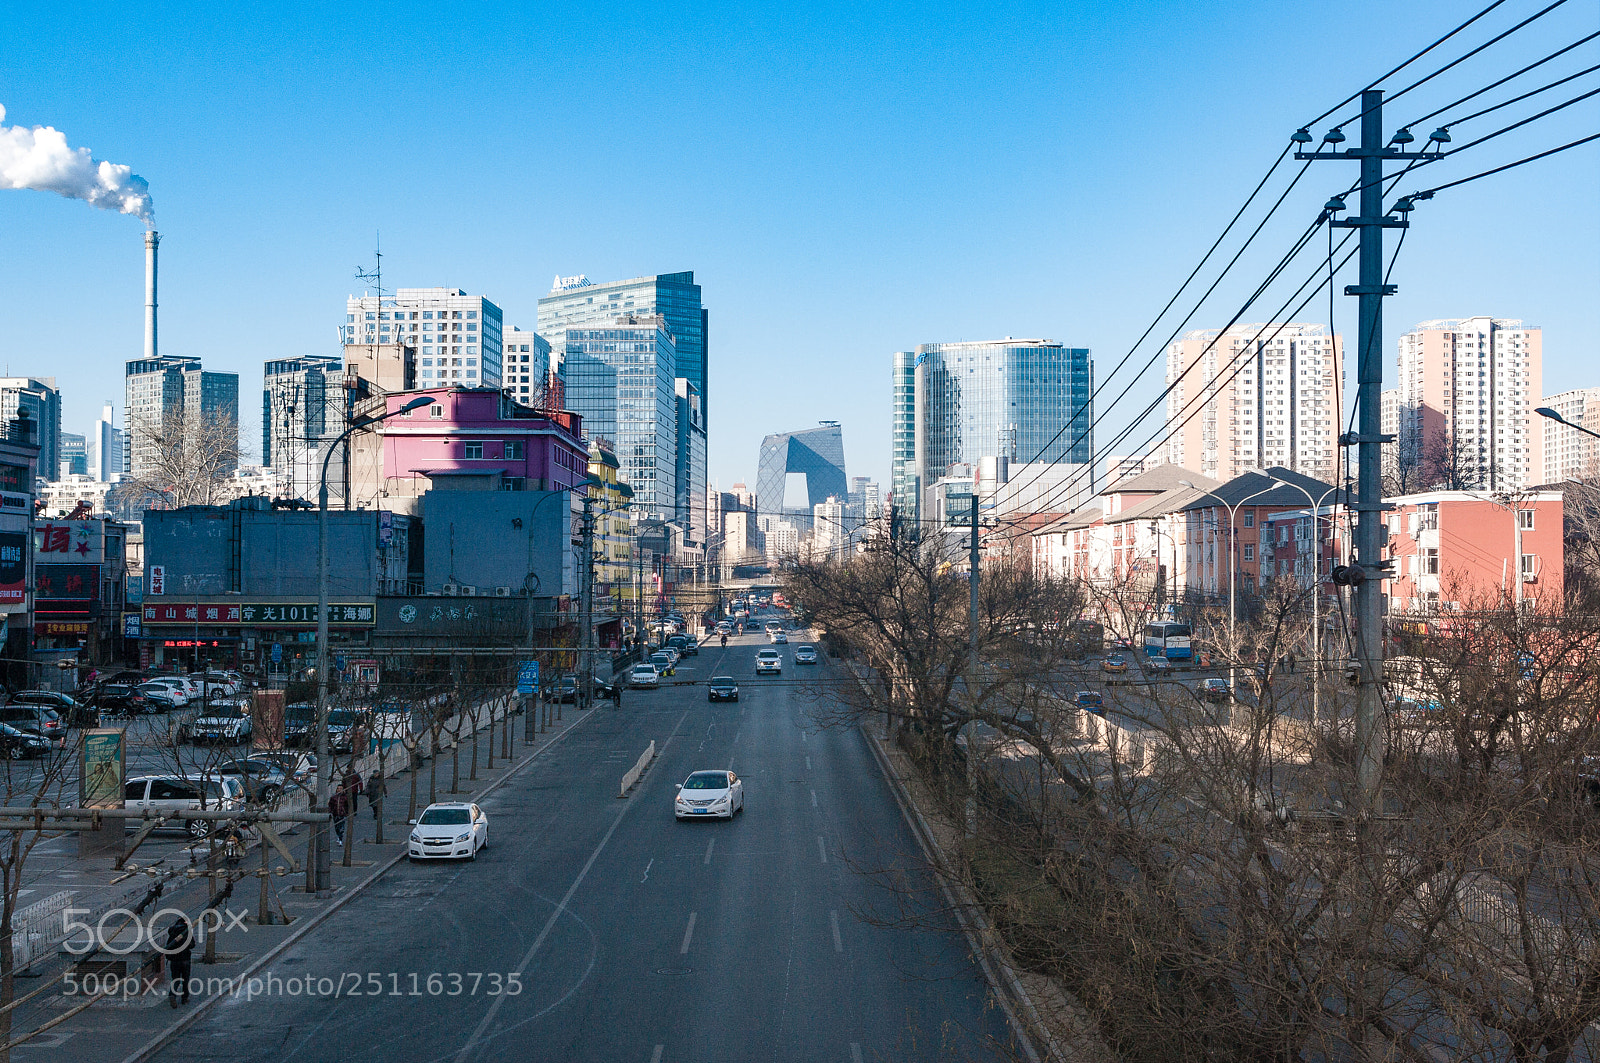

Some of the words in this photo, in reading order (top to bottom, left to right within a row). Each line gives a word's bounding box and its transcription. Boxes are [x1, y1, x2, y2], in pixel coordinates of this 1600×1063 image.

[152, 567, 163, 594] 电玩城
[144, 607, 240, 620] 南山城烟酒
[242, 606, 309, 621] 章光101
[126, 616, 140, 635] 烟酒
